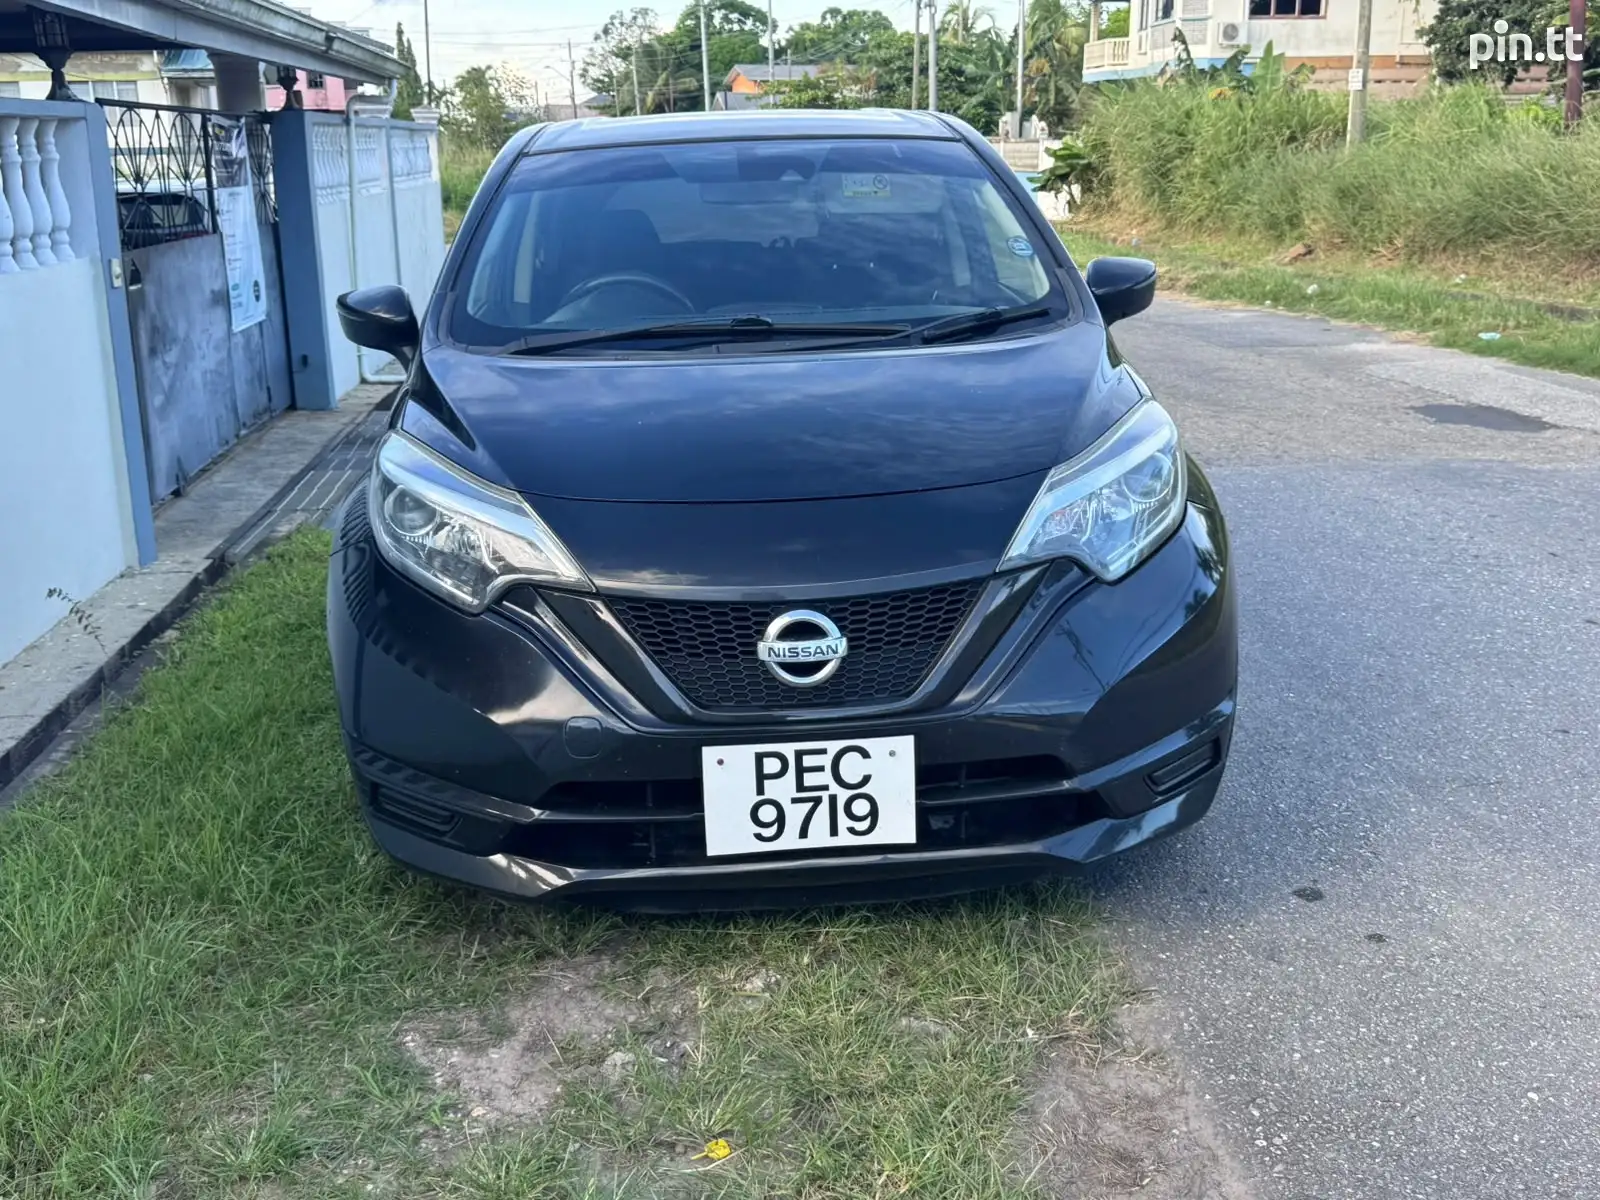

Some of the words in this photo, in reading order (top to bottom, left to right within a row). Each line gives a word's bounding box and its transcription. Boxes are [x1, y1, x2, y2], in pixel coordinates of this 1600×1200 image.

[767, 643, 839, 659] NISSAN
[754, 745, 873, 796] PEC
[749, 792, 880, 843] 9719
